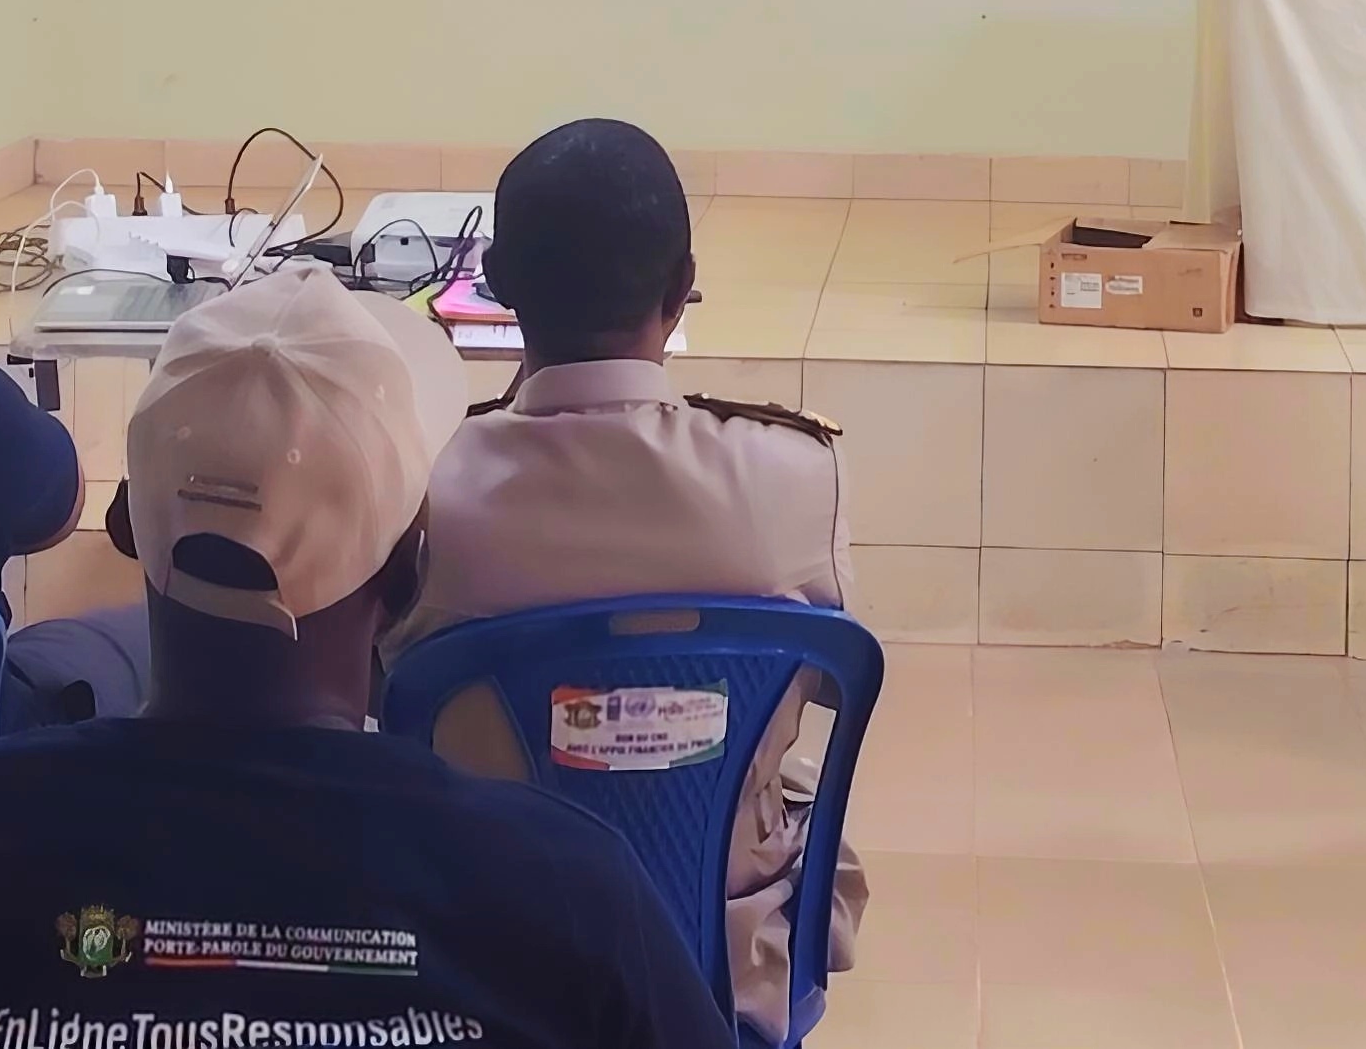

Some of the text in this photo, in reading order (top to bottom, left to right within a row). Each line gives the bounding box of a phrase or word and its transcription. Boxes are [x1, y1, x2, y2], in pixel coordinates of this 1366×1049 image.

[145, 920, 416, 947] MINISTÈRE DE LA COMMUNICATION
[144, 938, 418, 966] PORTE-PAROLE DU GOUVERNEMENT
